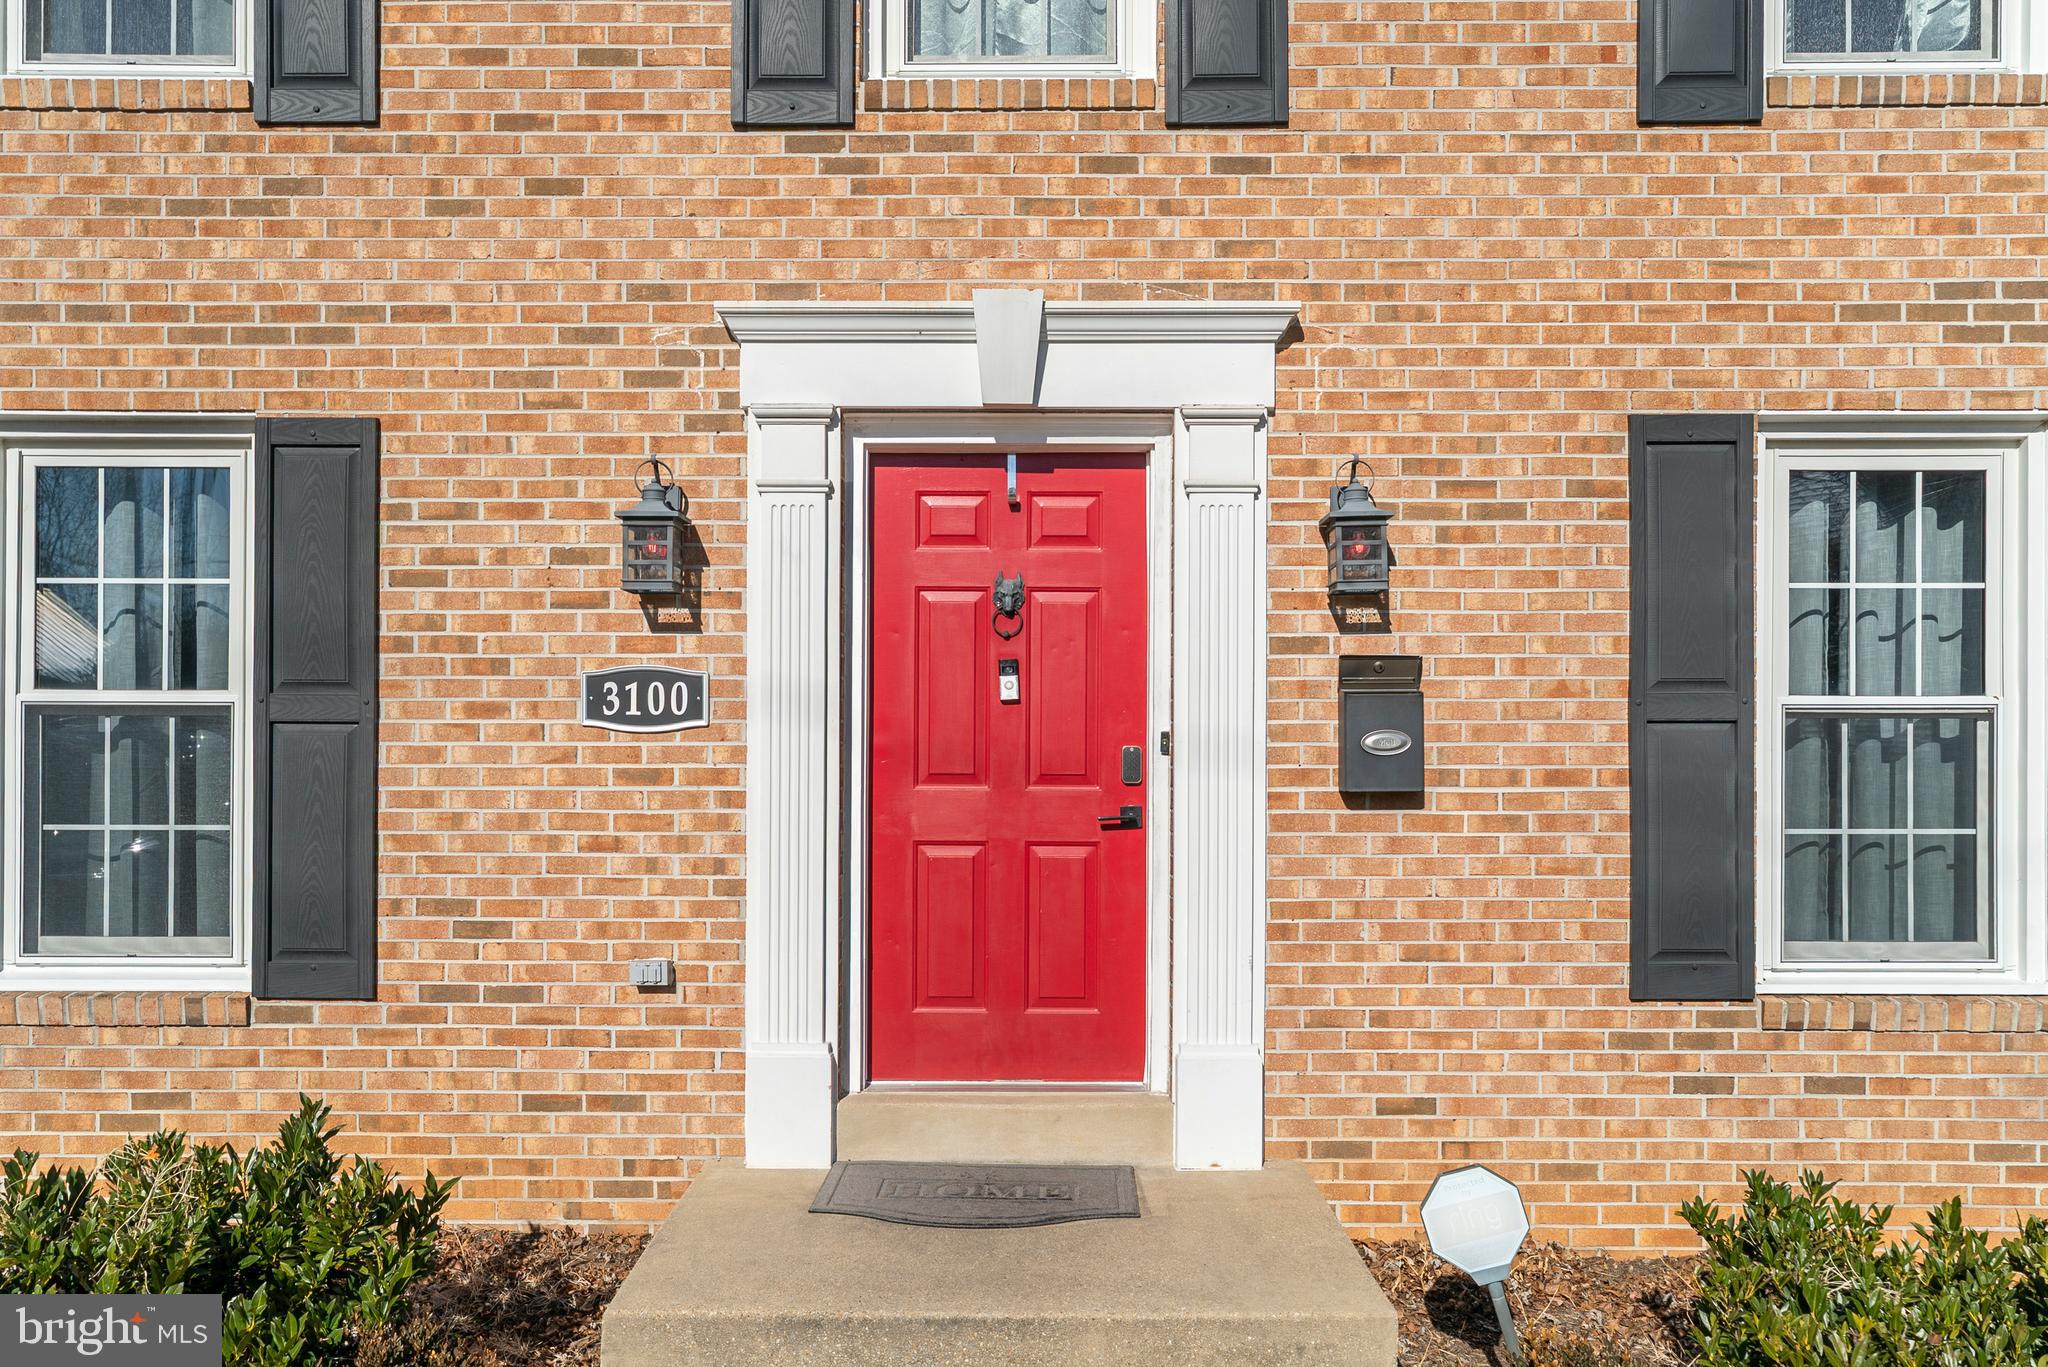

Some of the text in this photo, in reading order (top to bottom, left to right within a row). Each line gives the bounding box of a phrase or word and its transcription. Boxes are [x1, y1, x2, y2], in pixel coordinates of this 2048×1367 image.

[602, 681, 689, 716] 3100
[887, 1182, 1074, 1200] HOME
[1449, 1203, 1503, 1241] ring
